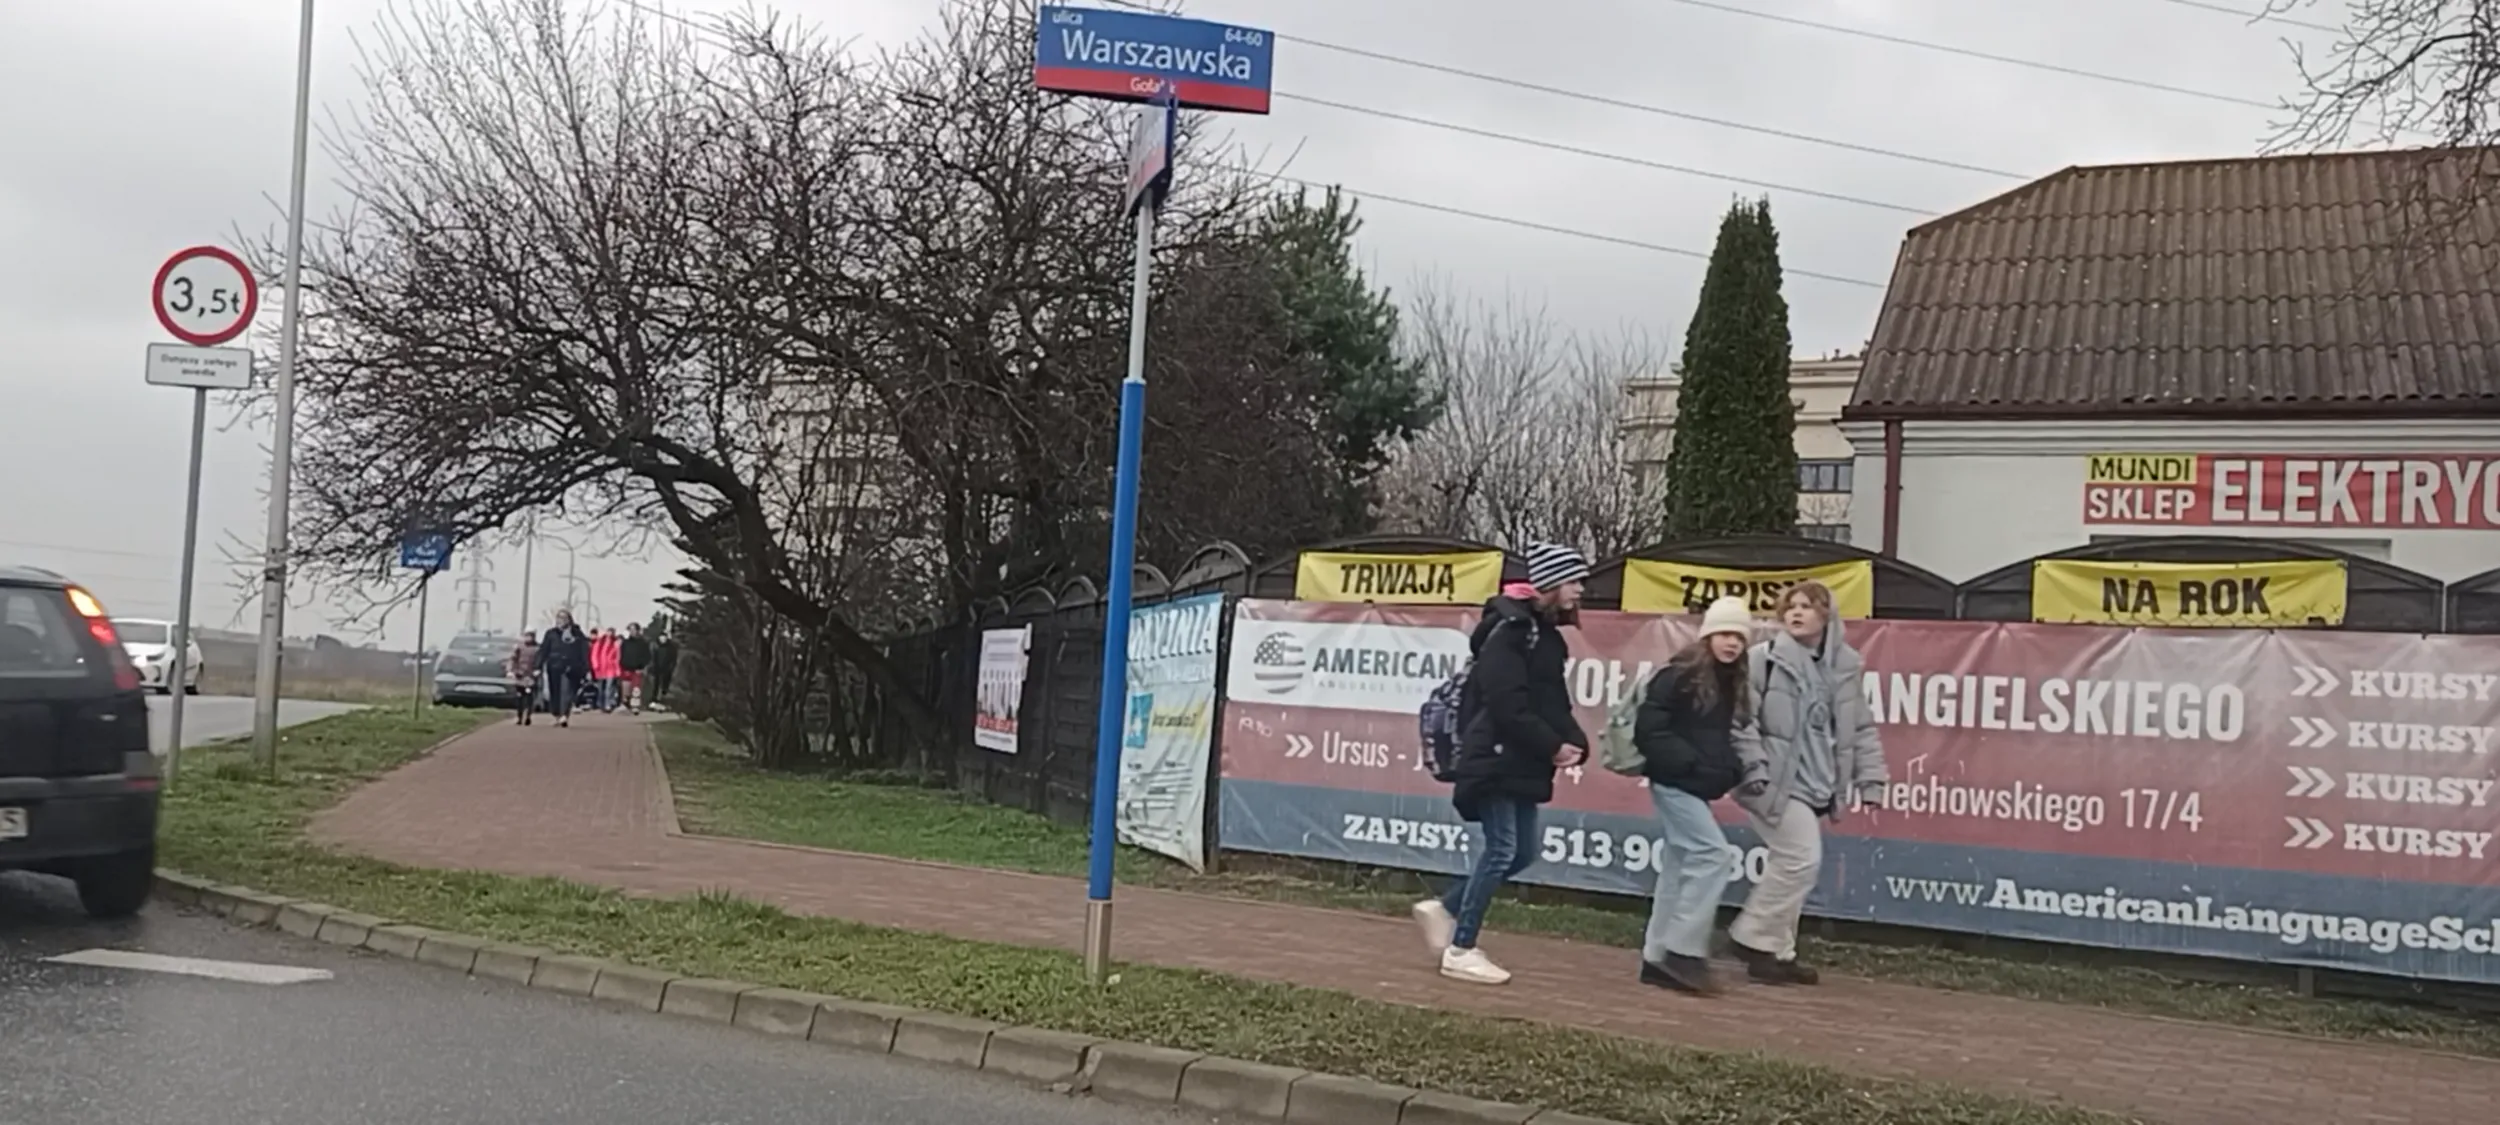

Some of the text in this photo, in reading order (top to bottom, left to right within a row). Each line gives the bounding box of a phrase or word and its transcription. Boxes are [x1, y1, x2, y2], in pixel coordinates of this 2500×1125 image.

[1052, 11, 1083, 25] ulica
[1062, 29, 1251, 80] Warszawska
[1225, 28, 1263, 47] 64-60
[170, 276, 240, 317] 3,5t
[2091, 458, 2192, 482] MUNDI
[2089, 488, 2196, 520] SKLEP
[1340, 563, 1456, 601] TRWAJĄ
[1680, 575, 1808, 611] ZAPIS
[2103, 576, 2272, 616] NA ROK
[1312, 648, 1457, 679] AMERICAN
[2350, 670, 2497, 701] KURSY
[1862, 671, 2244, 742] ANGIELSKIEGO
[1322, 731, 1389, 768] Ursus
[2348, 722, 2495, 753] KURSY
[2345, 772, 2494, 806] KURSY
[2119, 788, 2203, 832] 17/4
[1343, 814, 1470, 852] ZAPISY:
[1541, 826, 1613, 868] 513
[2344, 824, 2492, 859] KURSY
